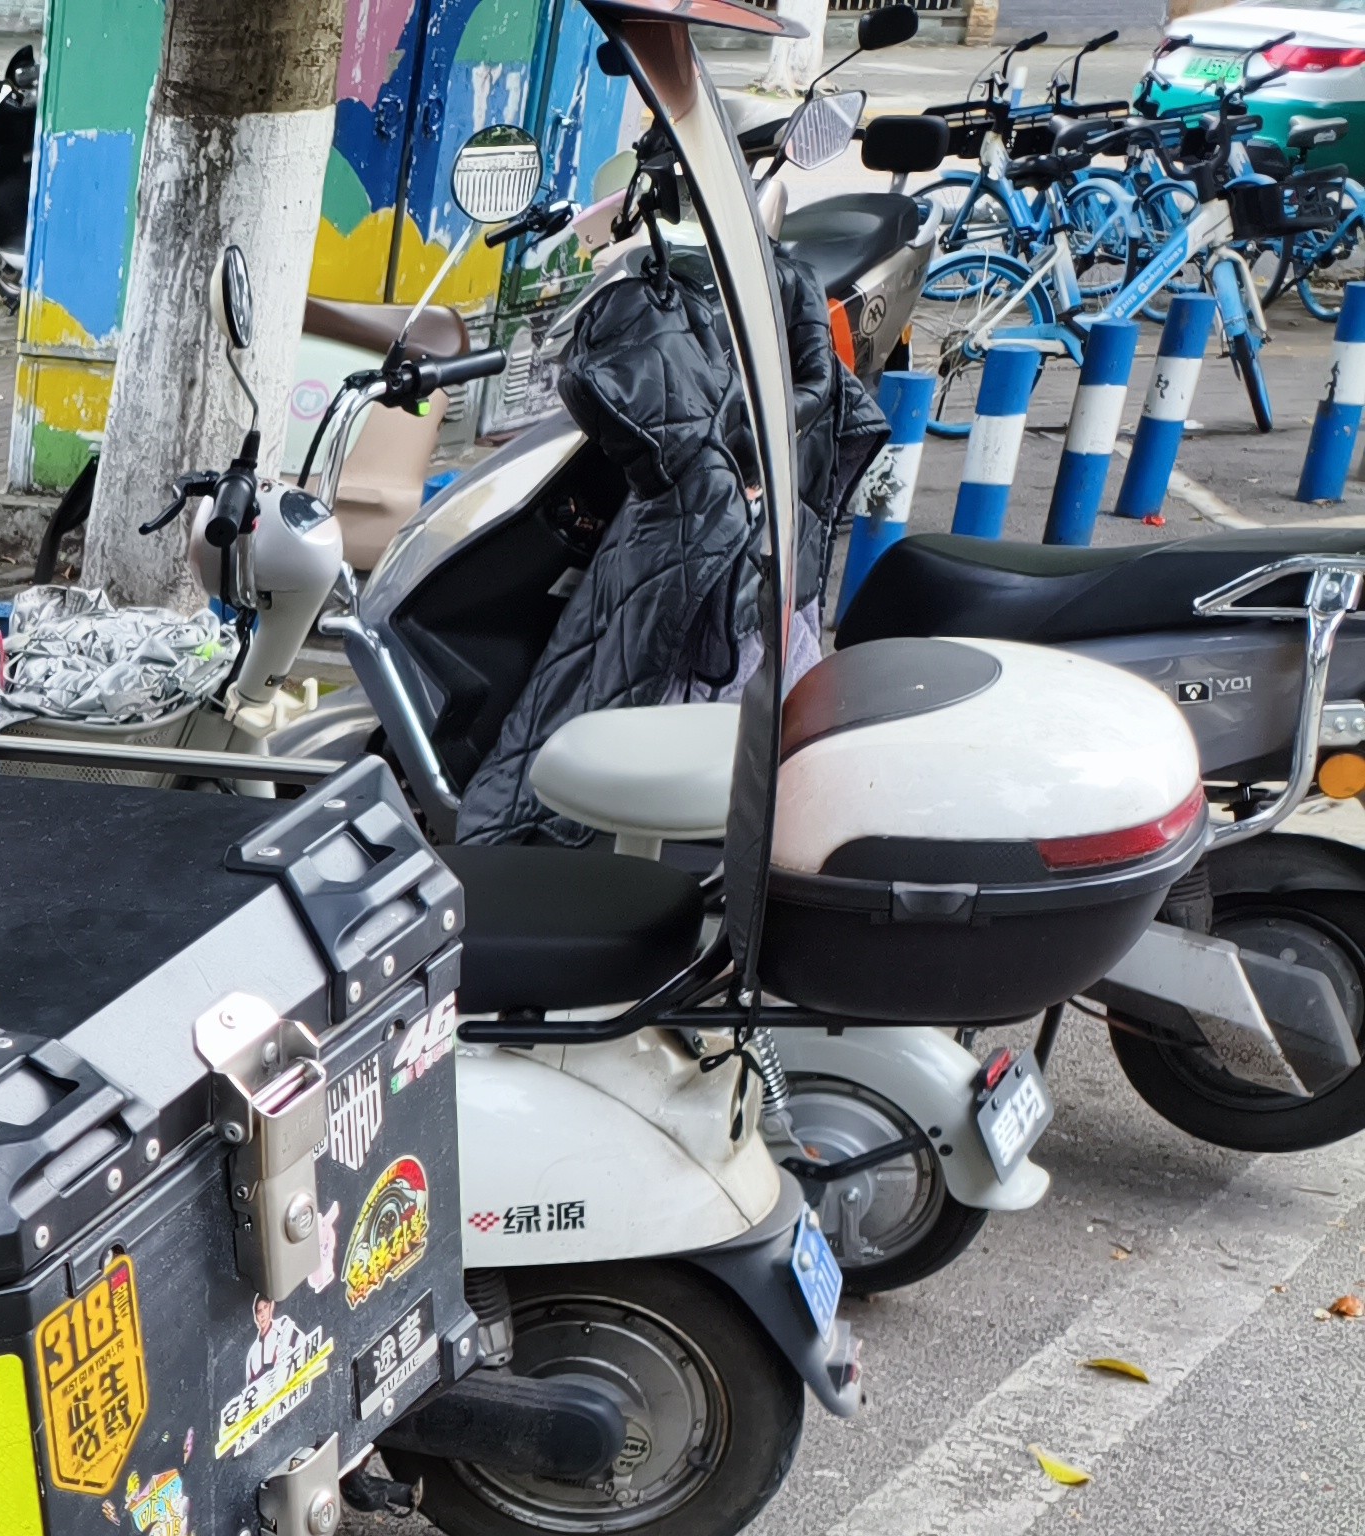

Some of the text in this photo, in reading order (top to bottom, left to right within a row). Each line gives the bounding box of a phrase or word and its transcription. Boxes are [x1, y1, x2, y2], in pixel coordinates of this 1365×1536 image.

[503, 1200, 585, 1234] 绿源
[45, 1280, 115, 1384] 318
[373, 1314, 422, 1384] 途者
[380, 1356, 421, 1398] TUZHE
